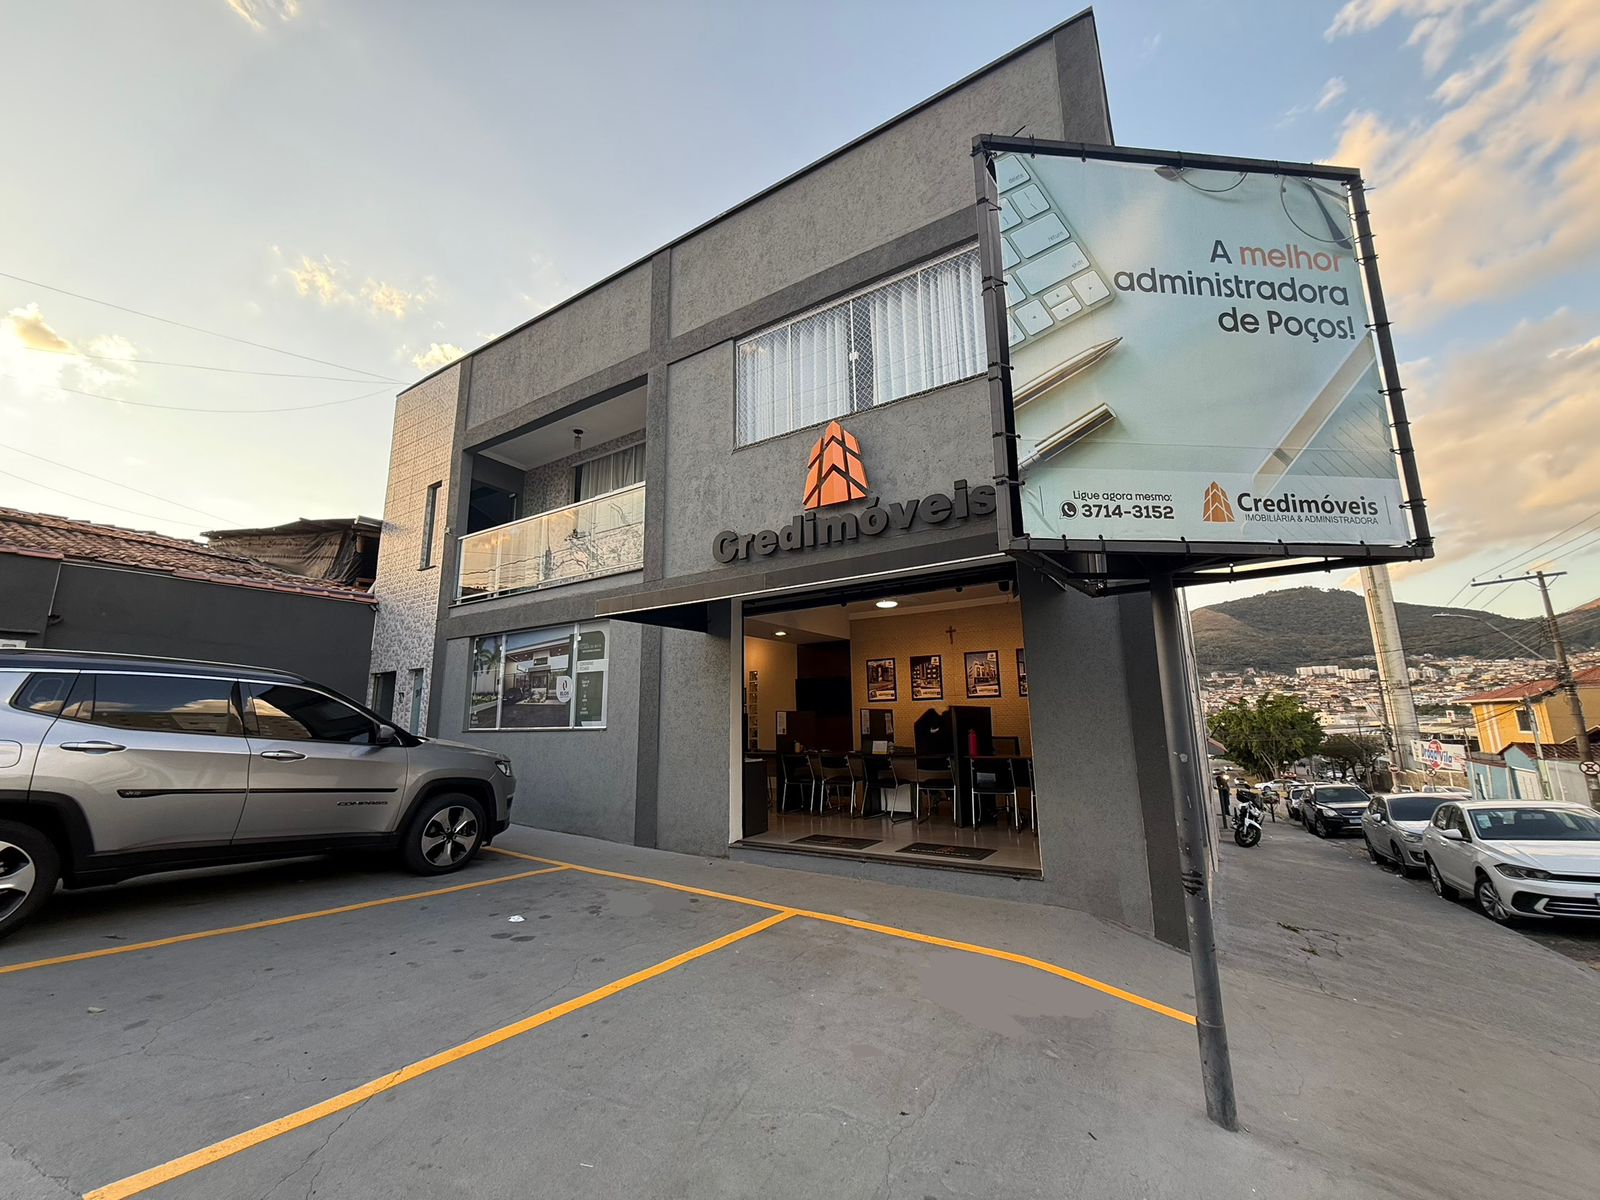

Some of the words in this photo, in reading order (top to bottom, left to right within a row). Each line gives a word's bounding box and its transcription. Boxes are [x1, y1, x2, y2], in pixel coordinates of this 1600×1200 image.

[1209, 239, 1232, 264] A
[1239, 243, 1343, 272] melhor
[1113, 267, 1350, 306] administradora
[1217, 306, 1260, 334] de
[1266, 310, 1356, 343] Poços!
[1073, 490, 1100, 502] Ligue
[1102, 491, 1133, 502] agora
[1135, 492, 1173, 502] mesmo:
[1237, 492, 1379, 516] Credimóveis
[712, 478, 997, 563] Credimóveis
[1081, 503, 1175, 520] 3714-3152
[1298, 514, 1304, 523] &
[1304, 515, 1379, 525] ADMINISTRADORA
